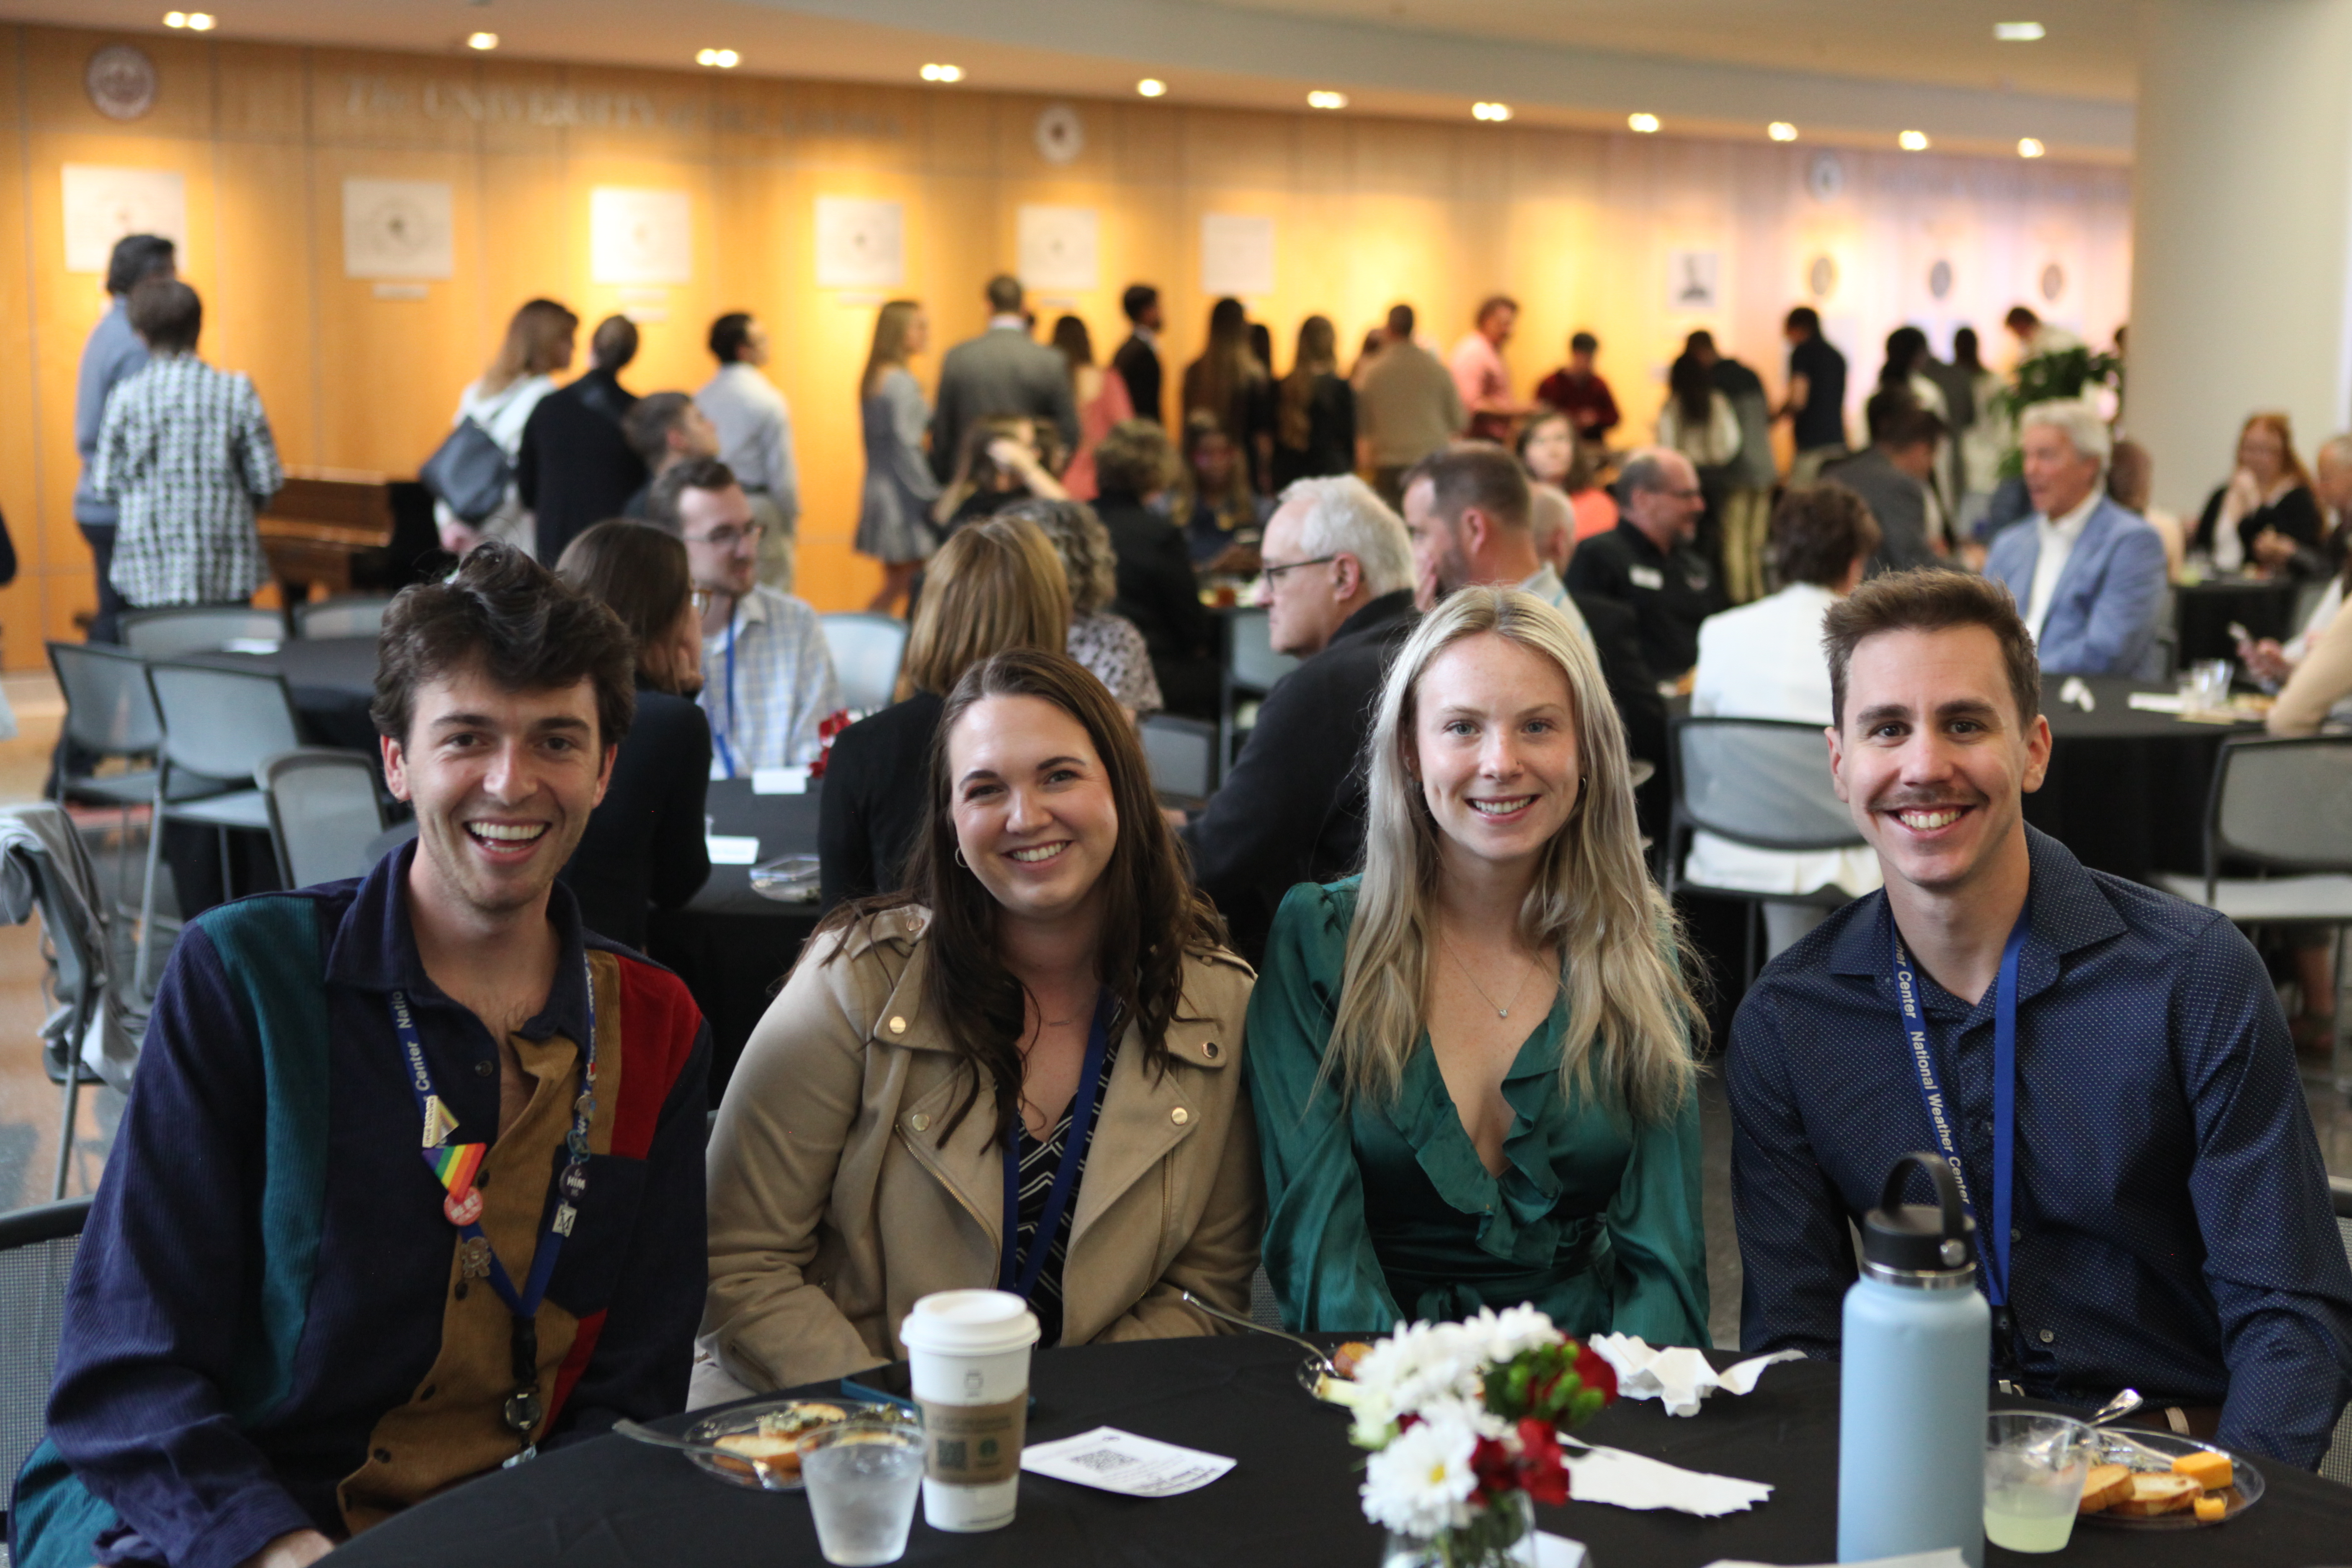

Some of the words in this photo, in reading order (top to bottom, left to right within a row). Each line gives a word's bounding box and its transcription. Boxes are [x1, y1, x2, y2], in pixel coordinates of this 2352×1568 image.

[391, 991, 413, 1029] Natio
[407, 1041, 431, 1091] Center
[1898, 970, 1916, 1019] Center
[1910, 1031, 1938, 1090] National
[1927, 1093, 1954, 1153] Weather
[1948, 1156, 1970, 1204] Center
